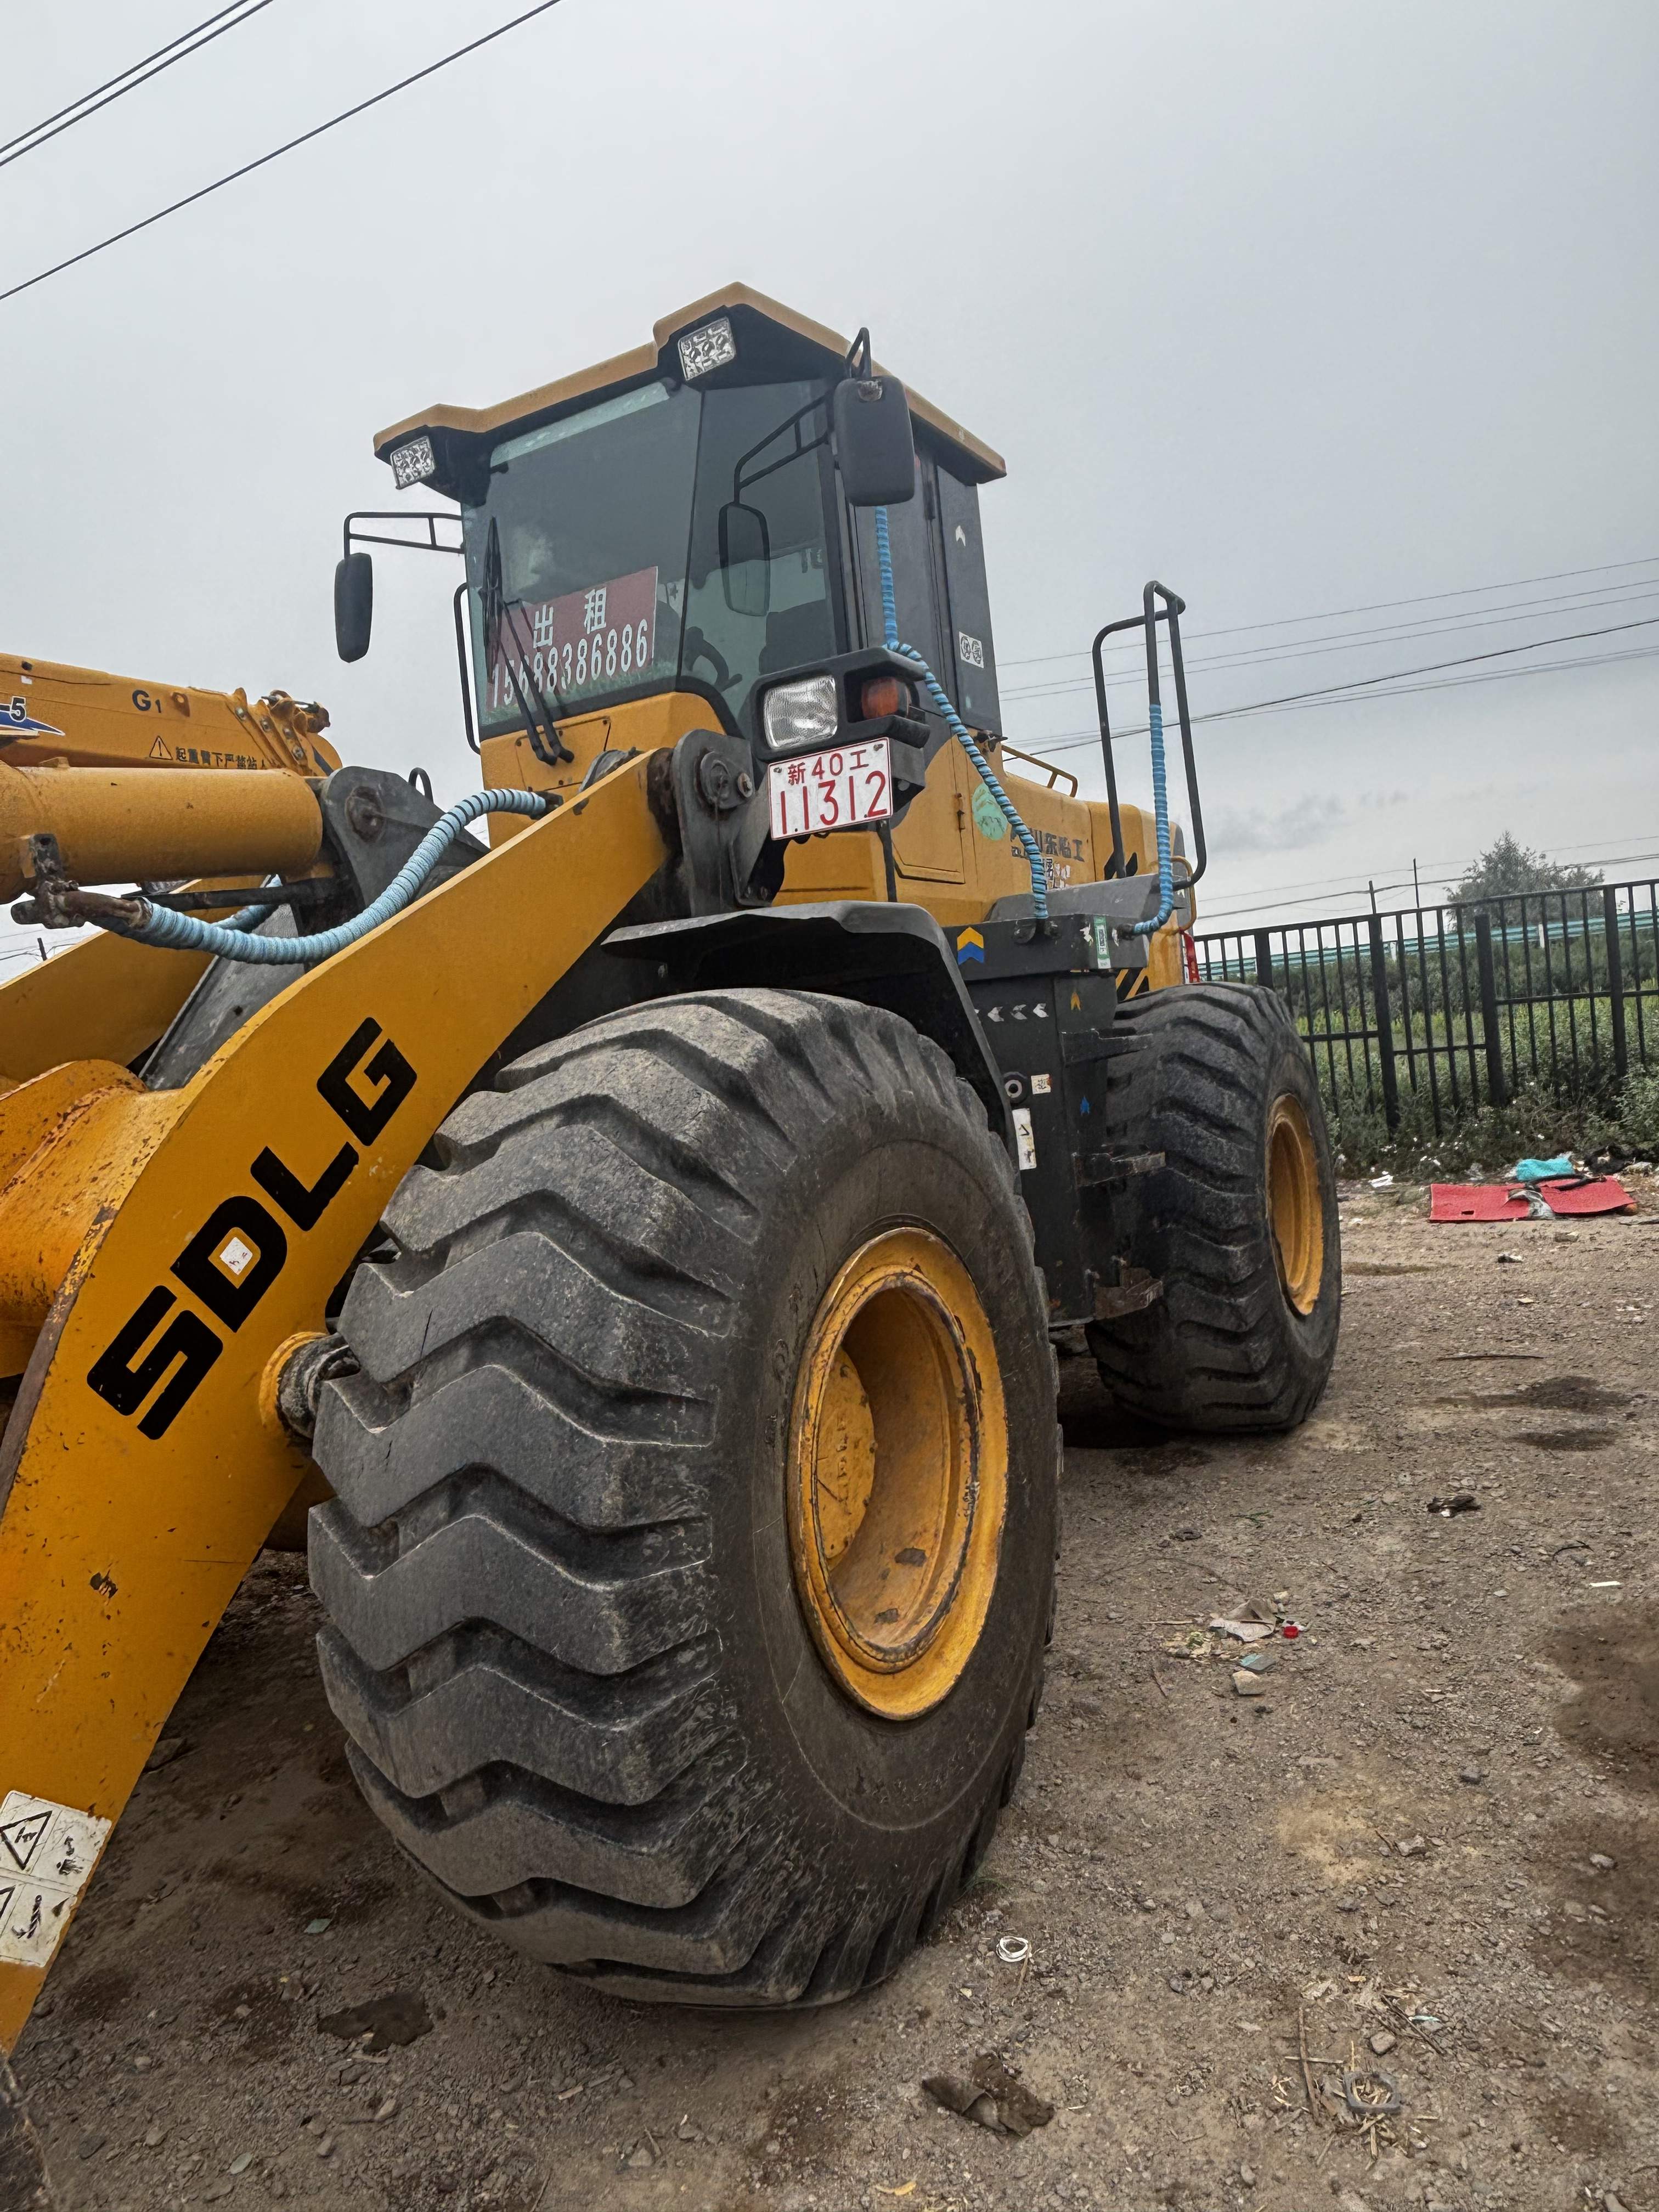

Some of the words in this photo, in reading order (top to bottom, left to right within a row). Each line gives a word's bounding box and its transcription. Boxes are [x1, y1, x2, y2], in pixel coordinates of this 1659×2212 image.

[533, 587, 607, 648] 出租
[788, 749, 869, 786] 新40工
[780, 770, 887, 834] 11312
[87, 1017, 417, 1440] SDLG
